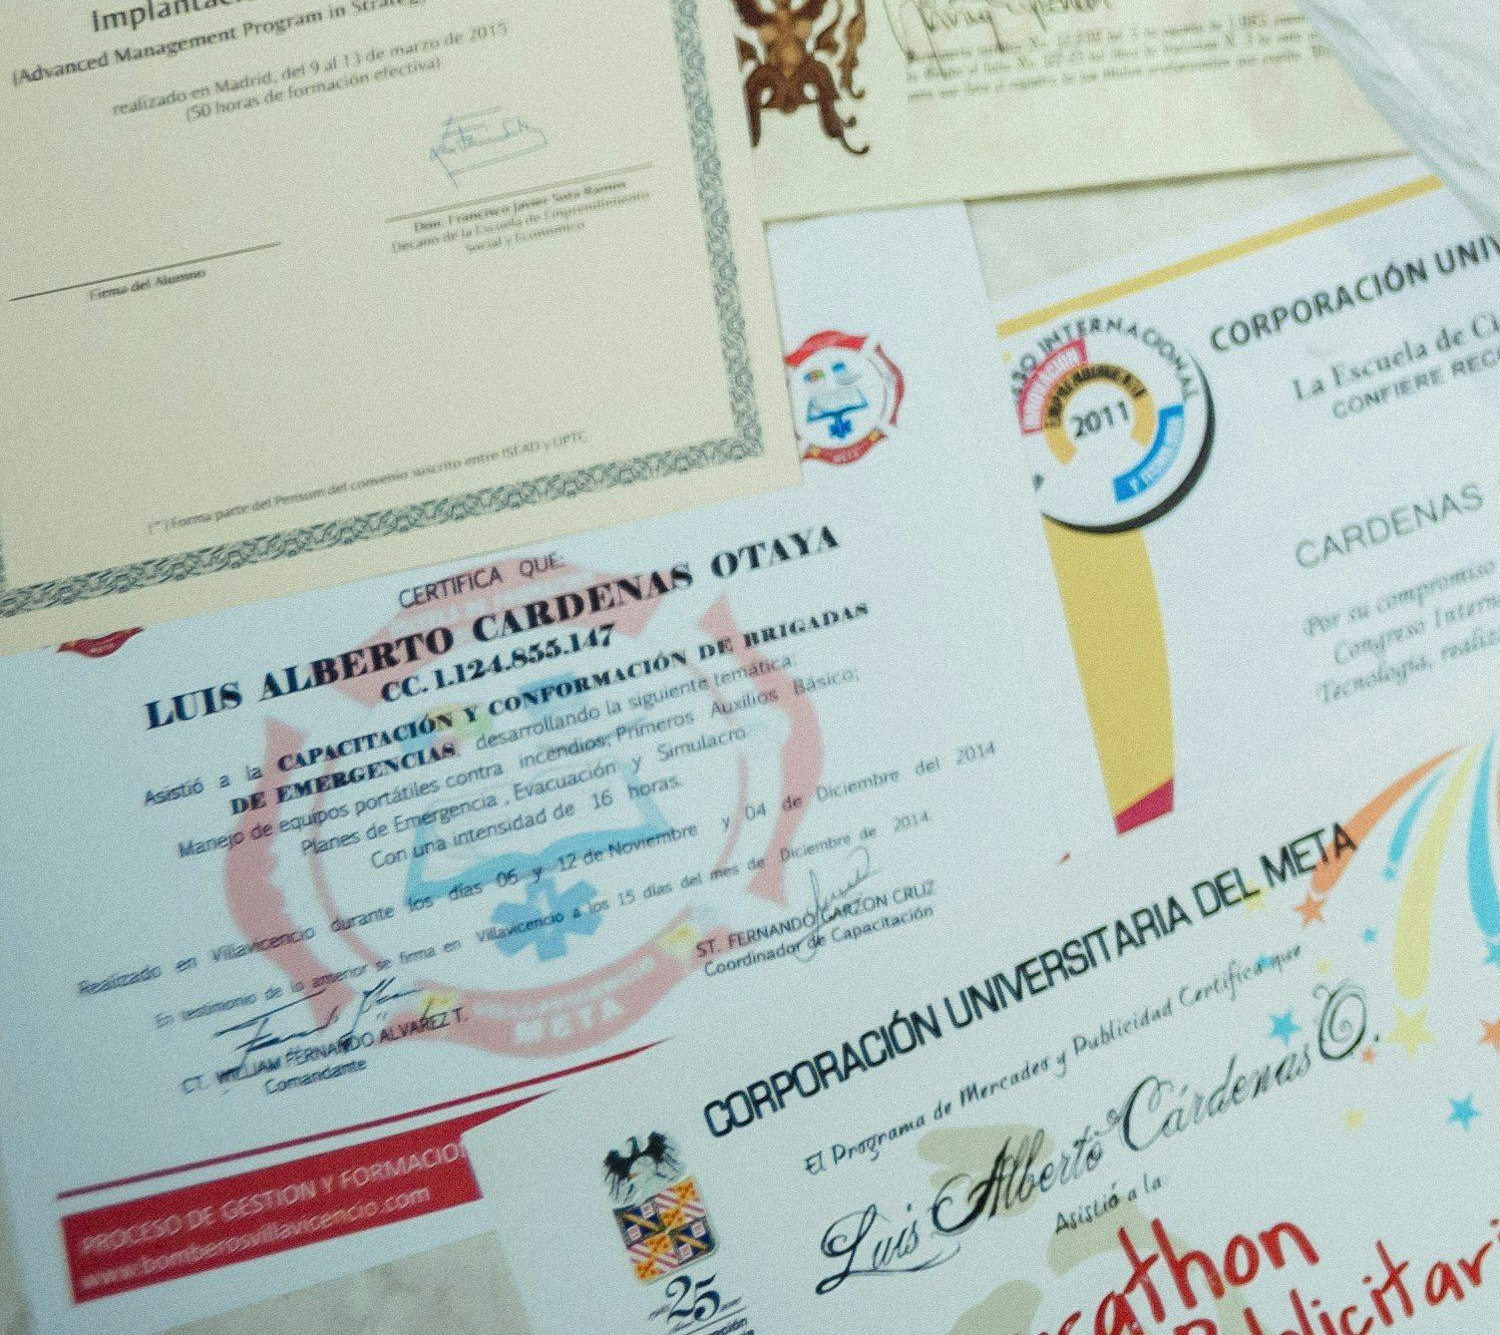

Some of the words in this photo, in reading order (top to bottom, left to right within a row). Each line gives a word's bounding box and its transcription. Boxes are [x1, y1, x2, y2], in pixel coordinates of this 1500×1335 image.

[1072, 396, 1131, 438] 2011
[1294, 480, 1486, 571] CARDENAS
[144, 680, 242, 732] LUIS
[258, 626, 454, 705] ALBERTO
[471, 562, 694, 643] CARDENAS
[711, 526, 840, 583] OTAYA
[380, 673, 428, 703] CC.
[432, 624, 614, 691] 1.124.855.147
[701, 1005, 944, 1137] CORPORACIÓN
[945, 892, 1195, 1025] UNIVERSITARIA
[1195, 867, 1257, 921] DEL
[1264, 822, 1358, 889] META
[664, 1277, 720, 1329] 25
